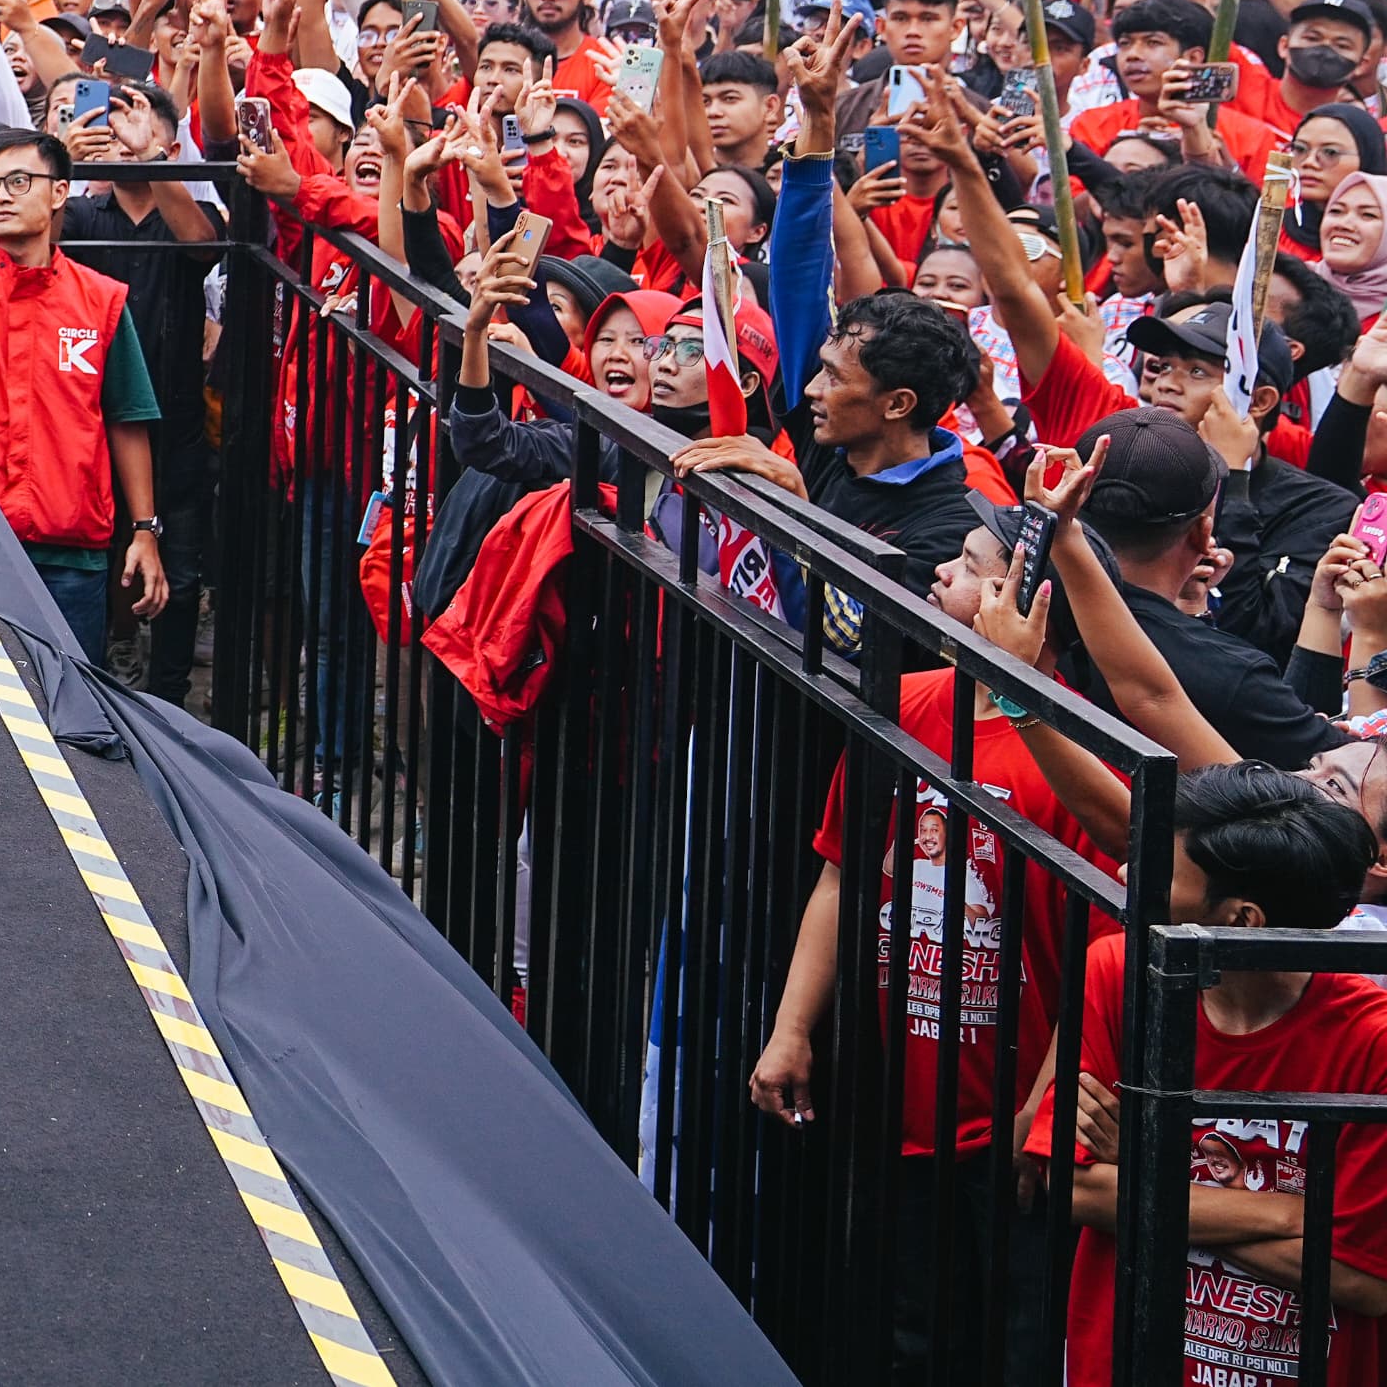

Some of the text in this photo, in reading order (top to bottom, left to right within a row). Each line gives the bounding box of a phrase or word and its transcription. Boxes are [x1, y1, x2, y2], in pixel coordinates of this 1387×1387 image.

[58, 327, 98, 339] CIRCLE
[58, 337, 99, 375] K
[1208, 1347, 1230, 1363] DPR
[1232, 1353, 1244, 1366] RI
[1246, 1357, 1264, 1370] PSI
[1266, 1360, 1289, 1374] NO.1
